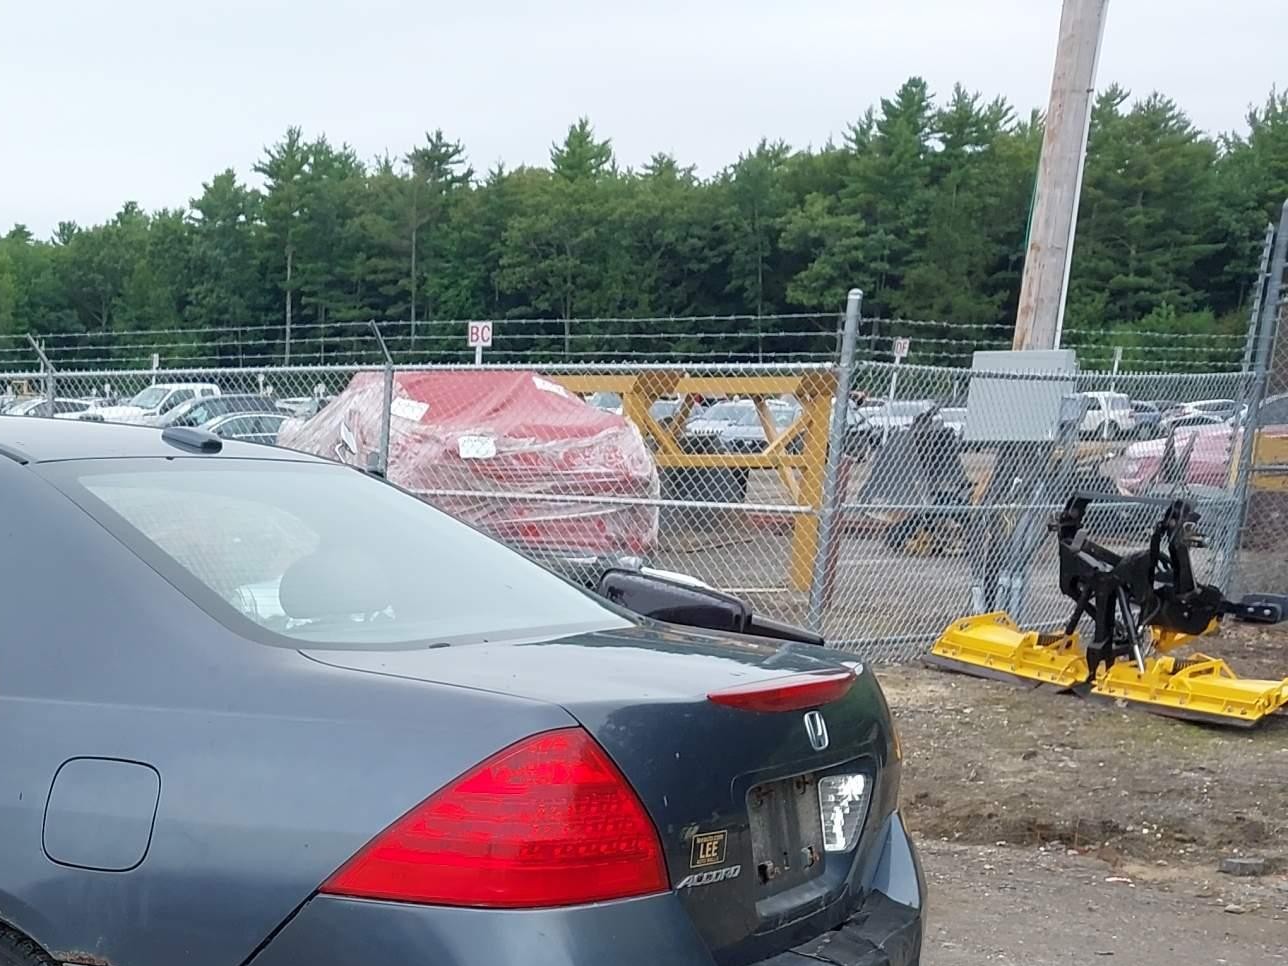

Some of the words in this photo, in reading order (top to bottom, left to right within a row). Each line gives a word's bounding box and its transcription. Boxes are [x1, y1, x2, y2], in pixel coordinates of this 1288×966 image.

[470, 324, 491, 343] BC
[699, 841, 719, 858] LEE
[676, 864, 742, 890] ACCORD
